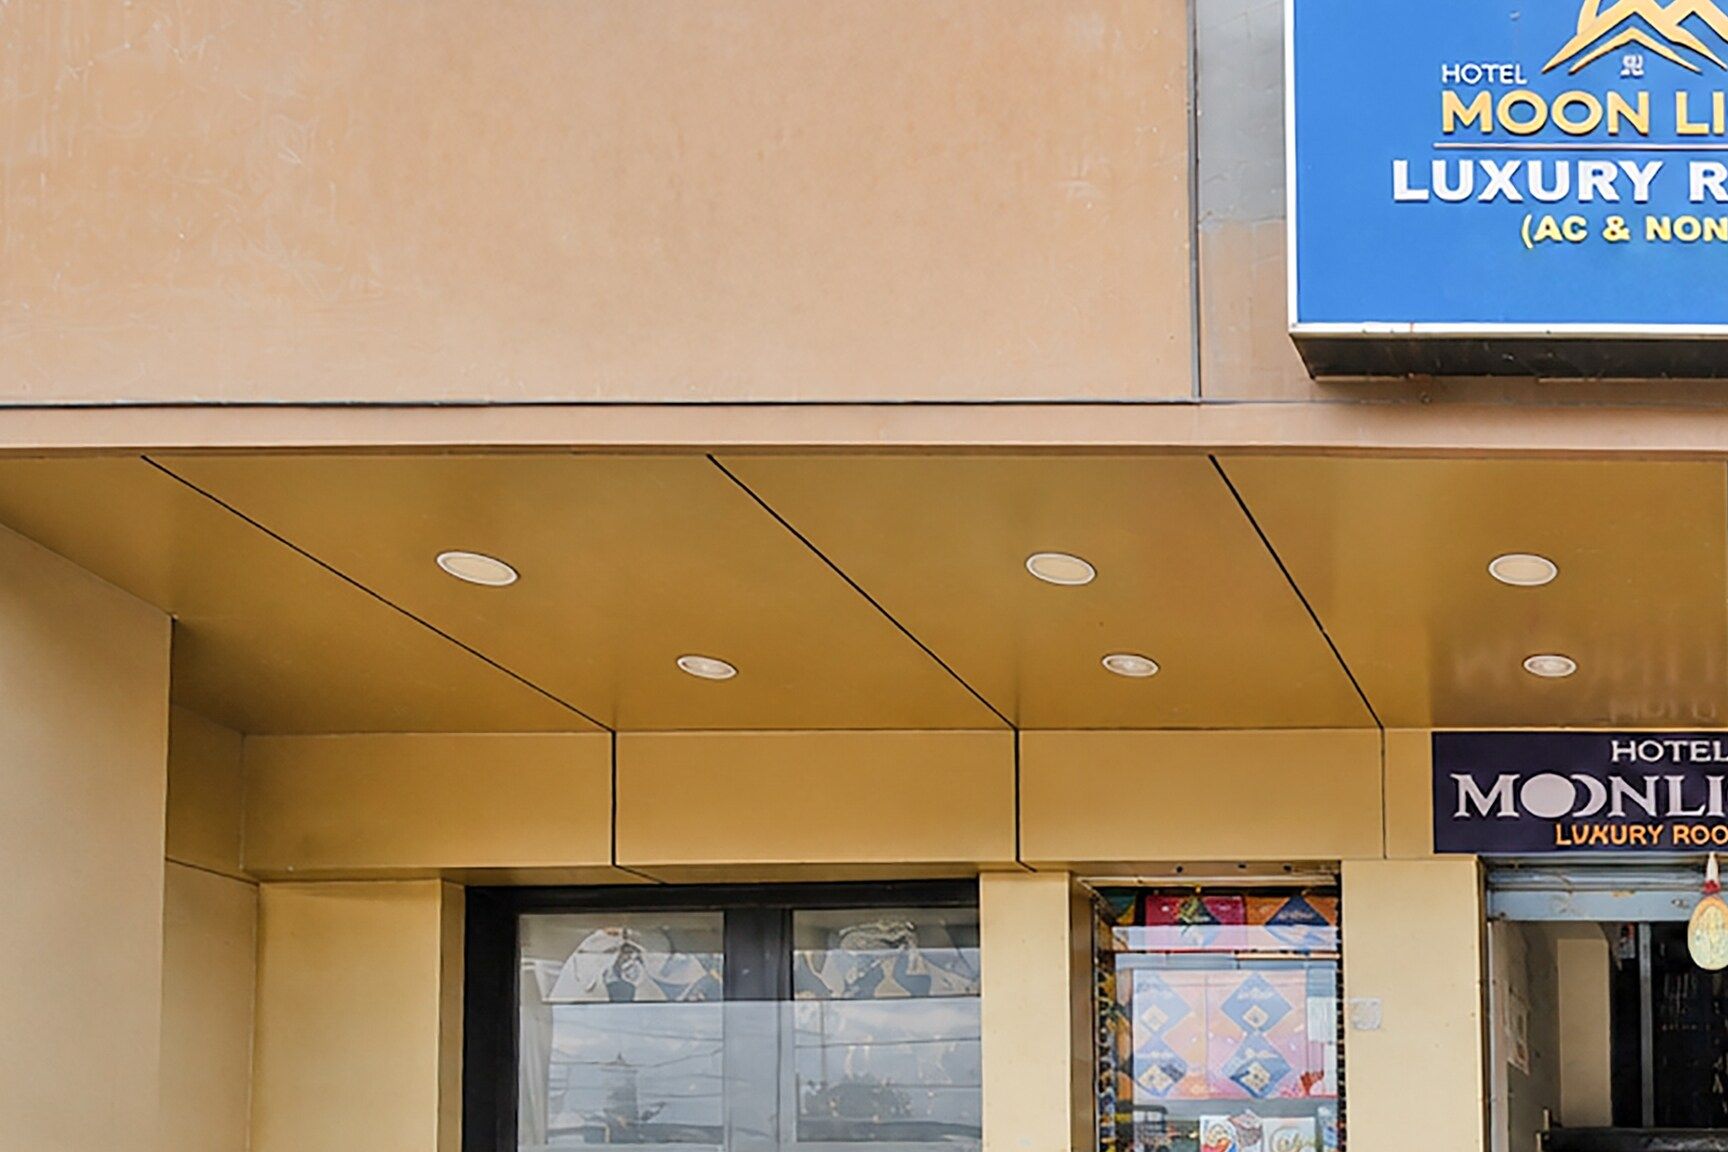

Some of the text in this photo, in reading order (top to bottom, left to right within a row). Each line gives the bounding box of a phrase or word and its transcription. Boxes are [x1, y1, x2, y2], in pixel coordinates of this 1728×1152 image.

[1441, 63, 1527, 85] HOTEL
[1442, 90, 1650, 136] MOON
[1392, 160, 1663, 203] LUXURY
[1521, 214, 1588, 249] (AC
[1602, 215, 1631, 242] &
[1555, 823, 1664, 847] LUXURY
